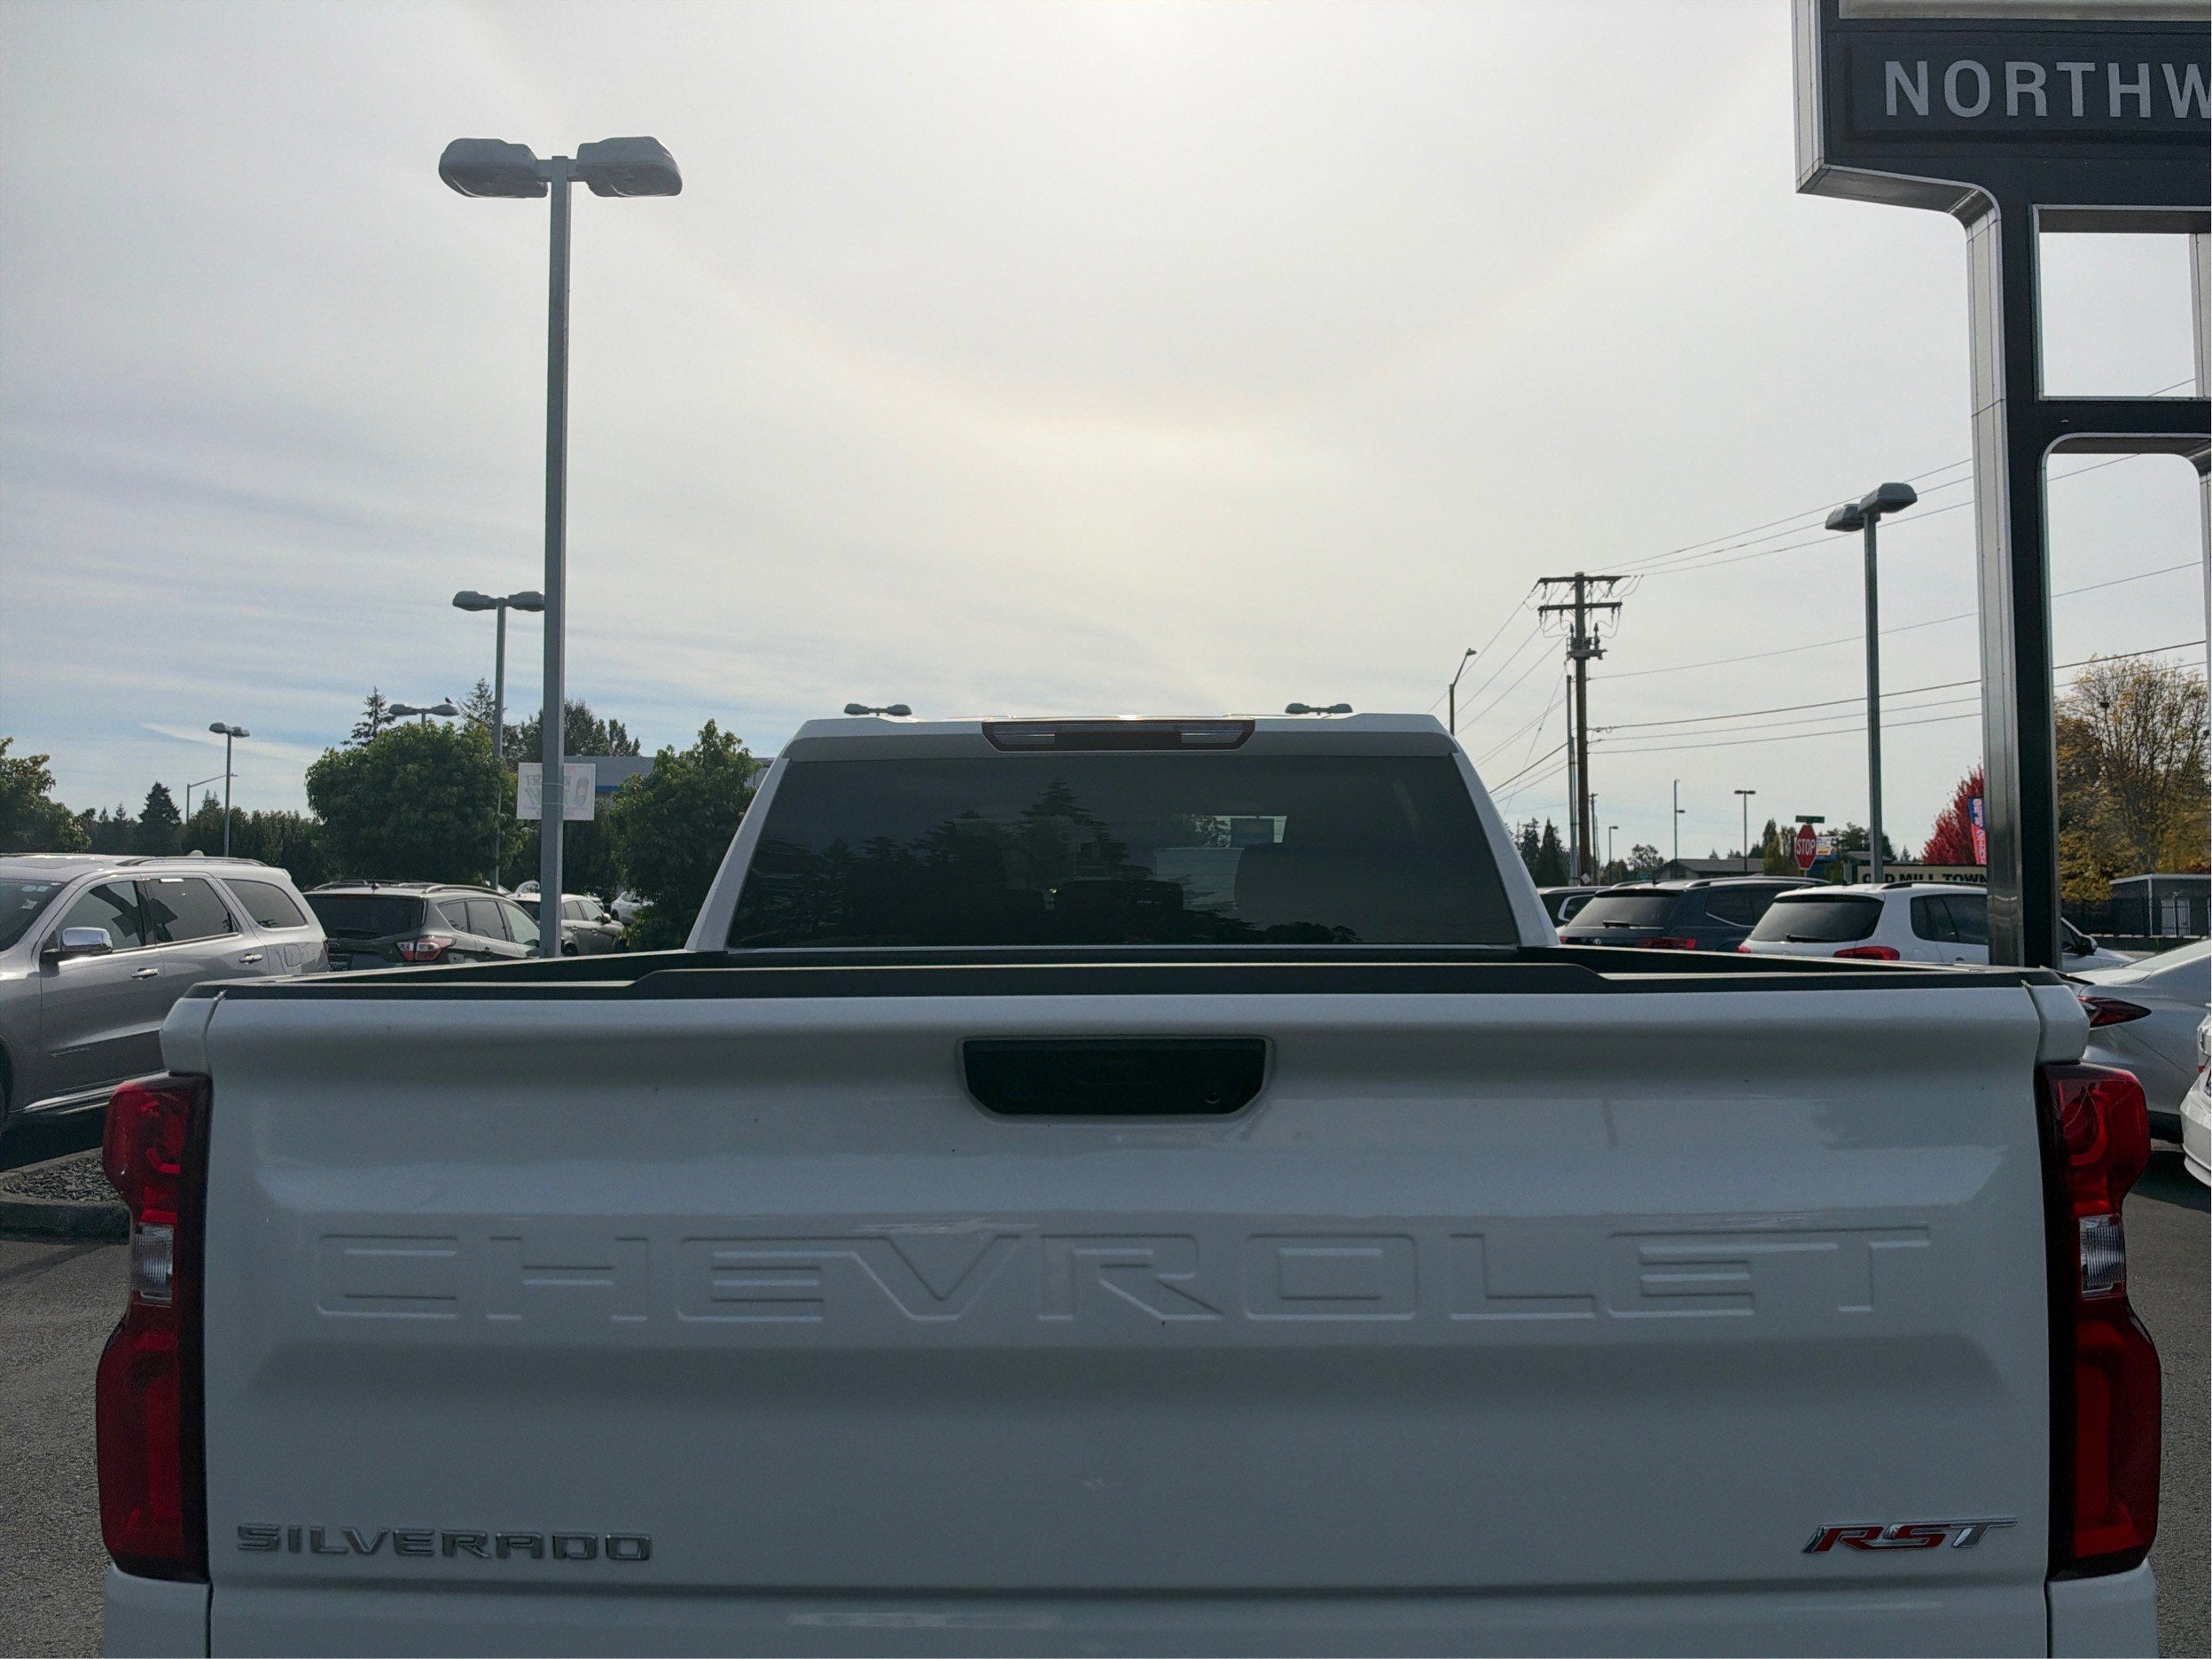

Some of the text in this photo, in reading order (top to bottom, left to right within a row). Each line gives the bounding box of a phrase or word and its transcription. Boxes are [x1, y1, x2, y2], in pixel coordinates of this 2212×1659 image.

[1884, 59, 2211, 119] NORTHW
[1795, 838, 1816, 856] STOP
[1862, 873, 1895, 884] OD
[317, 1226, 1931, 1321] CHEVROLET
[237, 1522, 653, 1561] SILVERADO
[1802, 1517, 2020, 1553] RST
